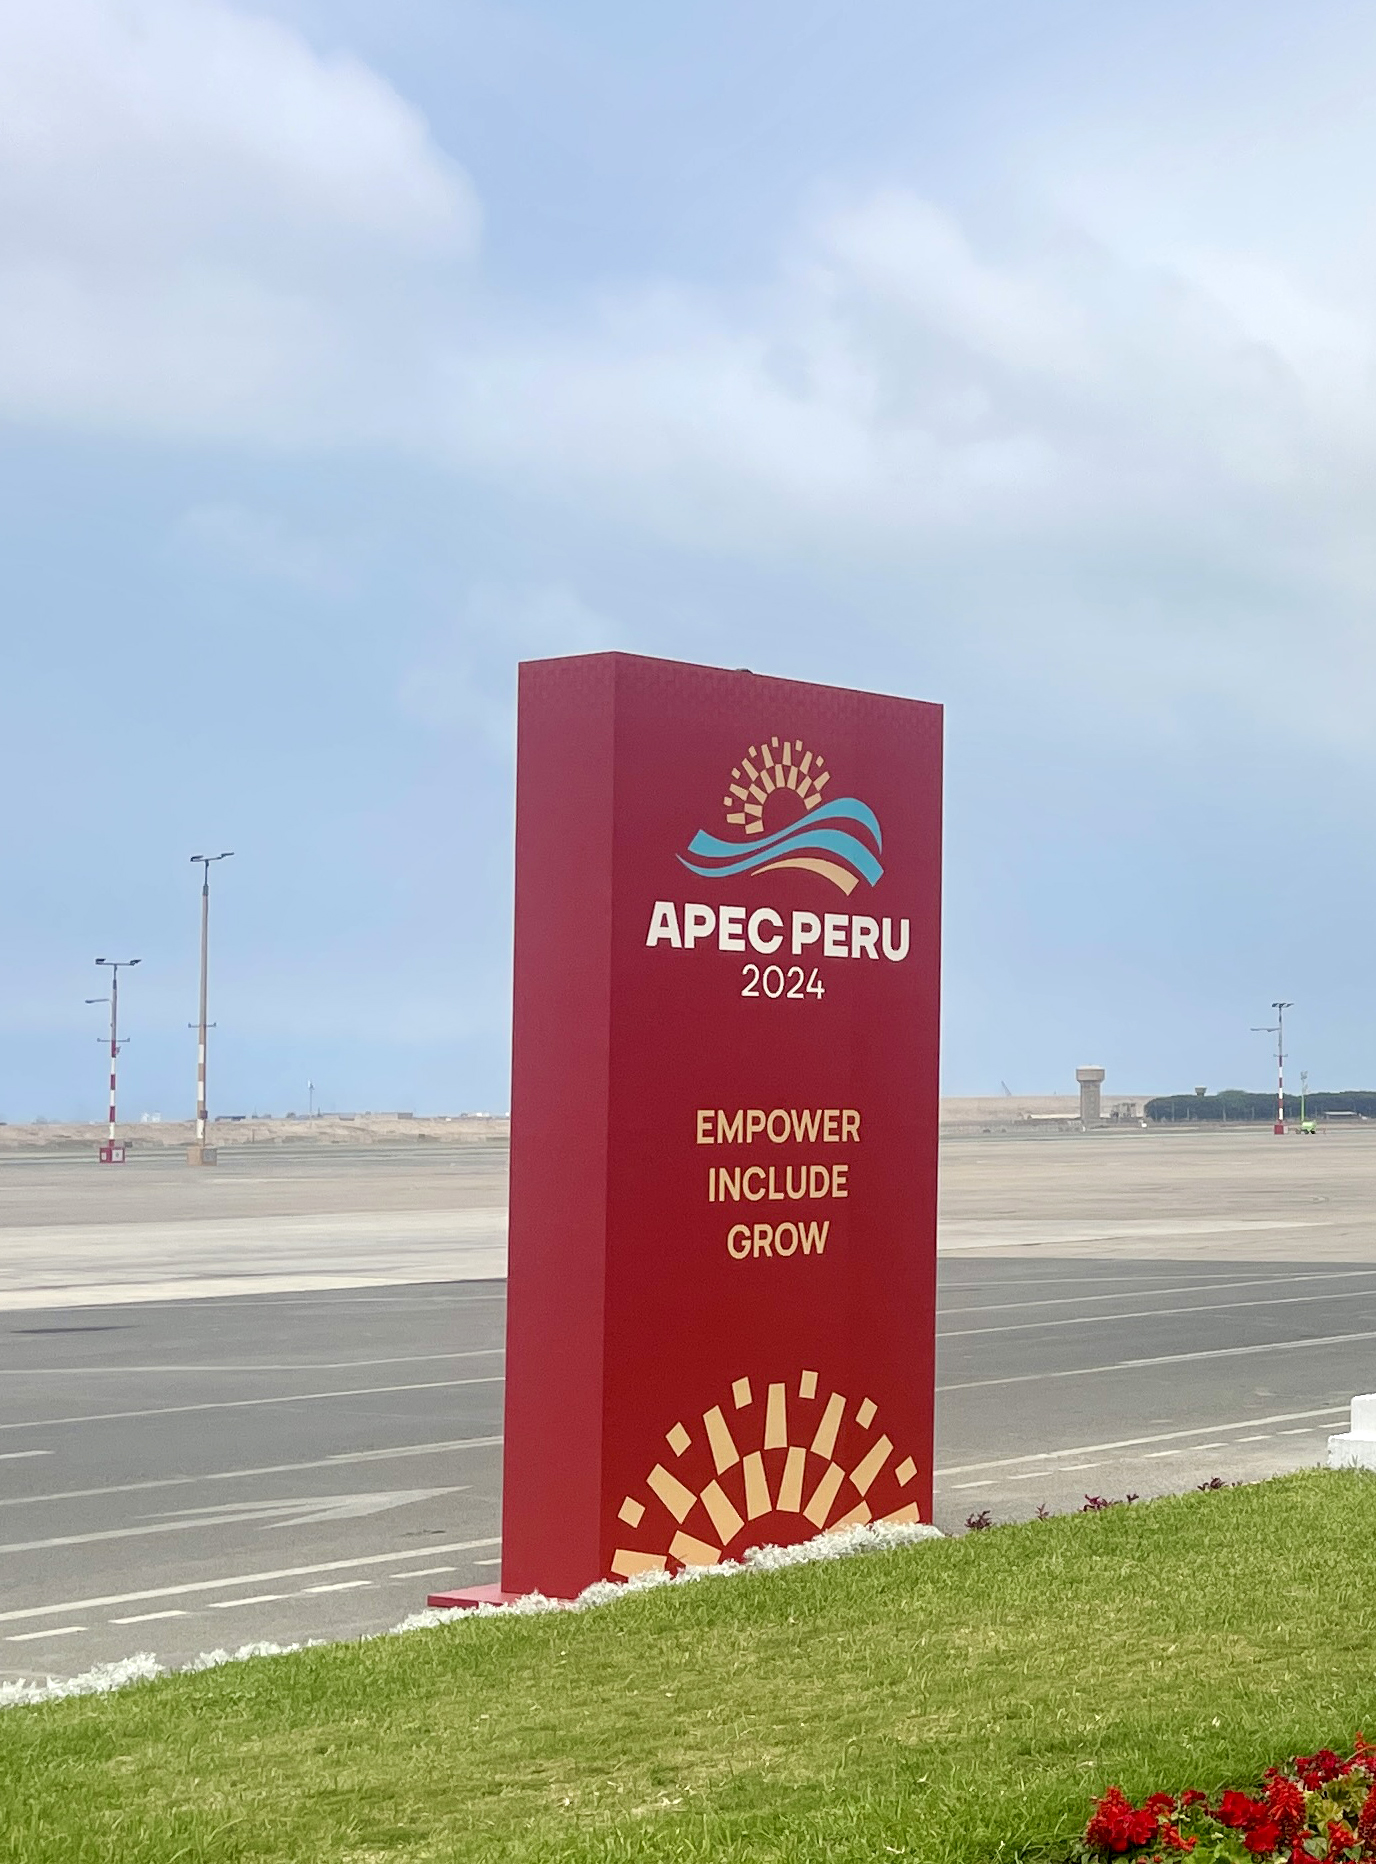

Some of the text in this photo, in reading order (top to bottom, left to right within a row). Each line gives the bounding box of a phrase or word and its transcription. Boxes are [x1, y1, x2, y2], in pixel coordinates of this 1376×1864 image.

[645, 900, 911, 962] APEC PERU
[740, 963, 826, 1000] 2024
[696, 1109, 861, 1144] EMPOWER
[708, 1164, 849, 1202] INCLUDE
[727, 1220, 830, 1260] GROW
